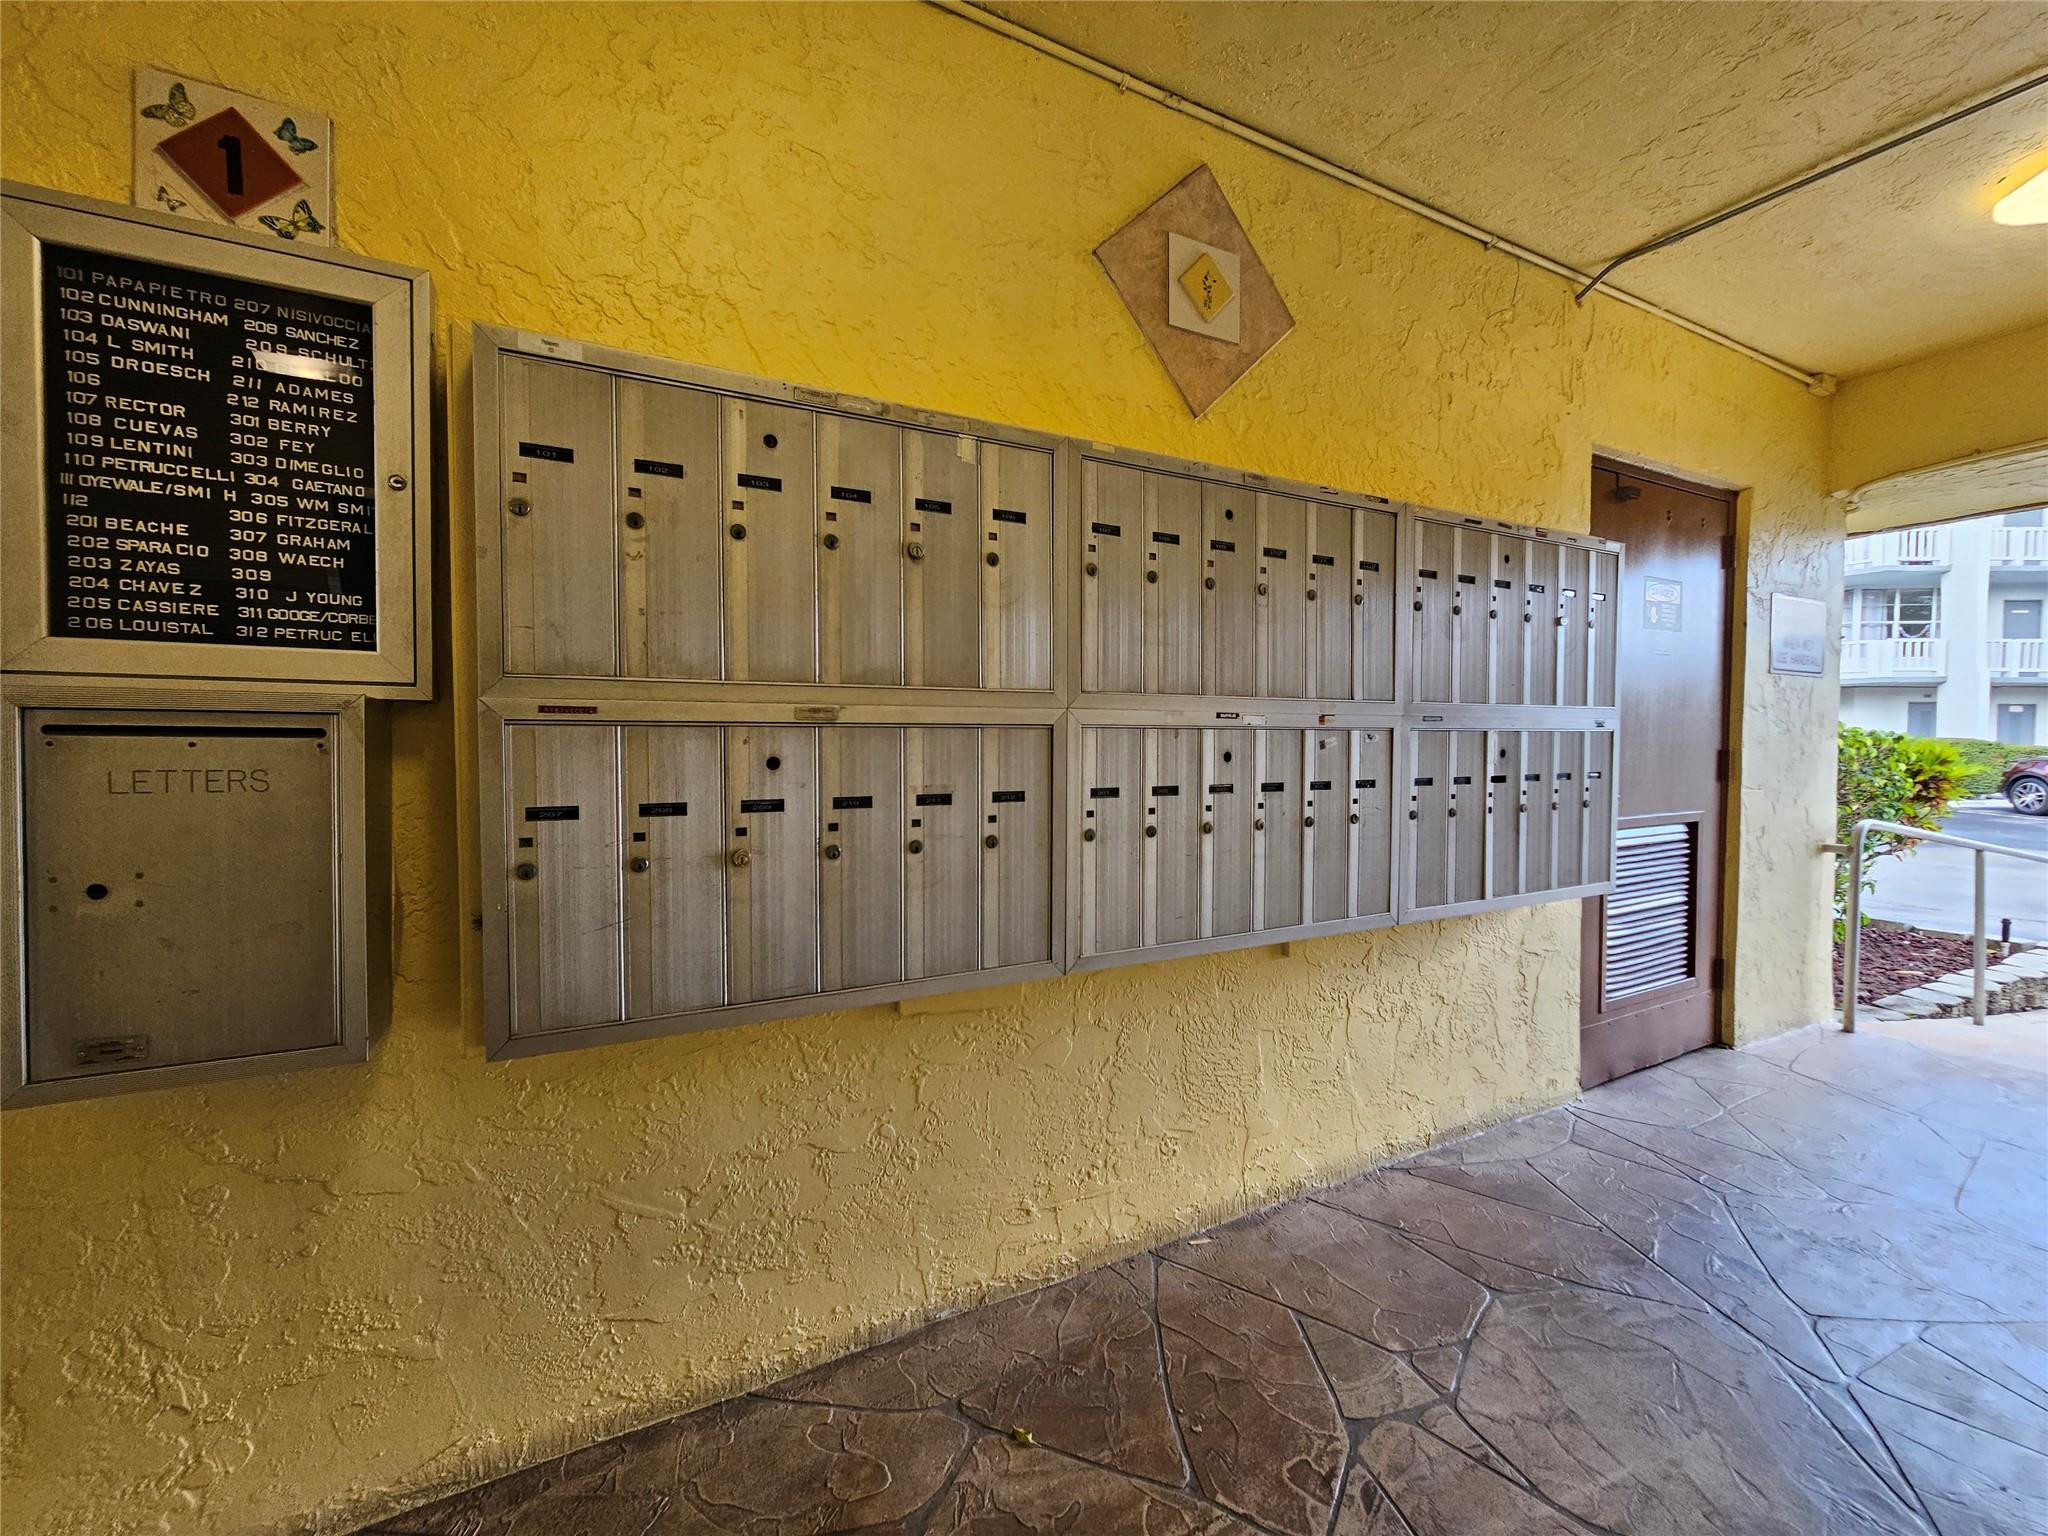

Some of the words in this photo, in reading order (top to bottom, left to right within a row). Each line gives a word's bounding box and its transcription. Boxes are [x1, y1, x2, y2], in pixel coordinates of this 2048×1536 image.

[217, 134, 244, 196] 1
[56, 266, 82, 281] 101
[92, 272, 226, 306] PAPAPIETRO
[60, 287, 94, 303] 102
[99, 294, 228, 326] CUNNINGHAM
[234, 299, 270, 314] 207
[277, 306, 371, 334] NISIVOCCIA
[61, 308, 92, 323] 103
[102, 314, 189, 339] DASWANI
[244, 319, 277, 334] 208
[286, 327, 359, 349] SANCHEZ
[64, 329, 98, 344] 104
[108, 335, 120, 348] L
[132, 340, 193, 360] SMITH
[65, 350, 100, 365] 105
[112, 356, 210, 382] DROESCH
[68, 370, 100, 385] 106
[233, 375, 261, 389] 211
[276, 382, 353, 404] ADAMES
[66, 392, 97, 404] 107
[105, 396, 185, 417] RECTOR
[227, 394, 259, 408] 212
[270, 400, 357, 422] RAMIREZ
[67, 412, 101, 426] 108
[114, 418, 198, 438] CUEVAS
[230, 414, 259, 428] 301
[268, 419, 330, 437] BERRY
[68, 433, 103, 447] 109
[110, 438, 192, 458] LENTINI
[230, 433, 268, 448] 302
[280, 440, 314, 453] FEY
[65, 453, 94, 466] 110
[102, 457, 234, 482] PETRUCCELLI
[231, 452, 267, 466] 303
[276, 458, 363, 478] DIMEGLIO
[649, 465, 669, 473] 102
[60, 472, 73, 484] 111
[244, 473, 279, 487] 304
[292, 479, 364, 496] GAETANO
[64, 494, 88, 506] 112
[251, 493, 288, 507] 305
[296, 498, 328, 511] WM
[338, 502, 375, 516] SMI
[67, 514, 97, 528] 201
[106, 518, 188, 536] BEACHE
[229, 510, 267, 524] 306
[68, 535, 109, 548] 202
[116, 539, 208, 557] SPARACIO
[230, 529, 267, 542] 307
[277, 534, 350, 550] GRAHAM
[68, 556, 111, 569] 203
[120, 560, 180, 574] ZAYAS
[230, 548, 267, 562] 308
[278, 552, 344, 568] WAECH
[69, 576, 109, 589] 204
[120, 579, 202, 596] CHAVEZ
[232, 568, 271, 581] 309
[68, 596, 110, 609] 205
[118, 599, 219, 616] CASSIERE
[236, 588, 268, 600] 310
[286, 592, 296, 601] J
[306, 592, 362, 606] YOUNG
[238, 607, 262, 618] 311
[68, 617, 112, 629] 206
[120, 619, 213, 634] LOUISTAL
[236, 626, 267, 637] 312
[107, 768, 270, 795] LETTERS
